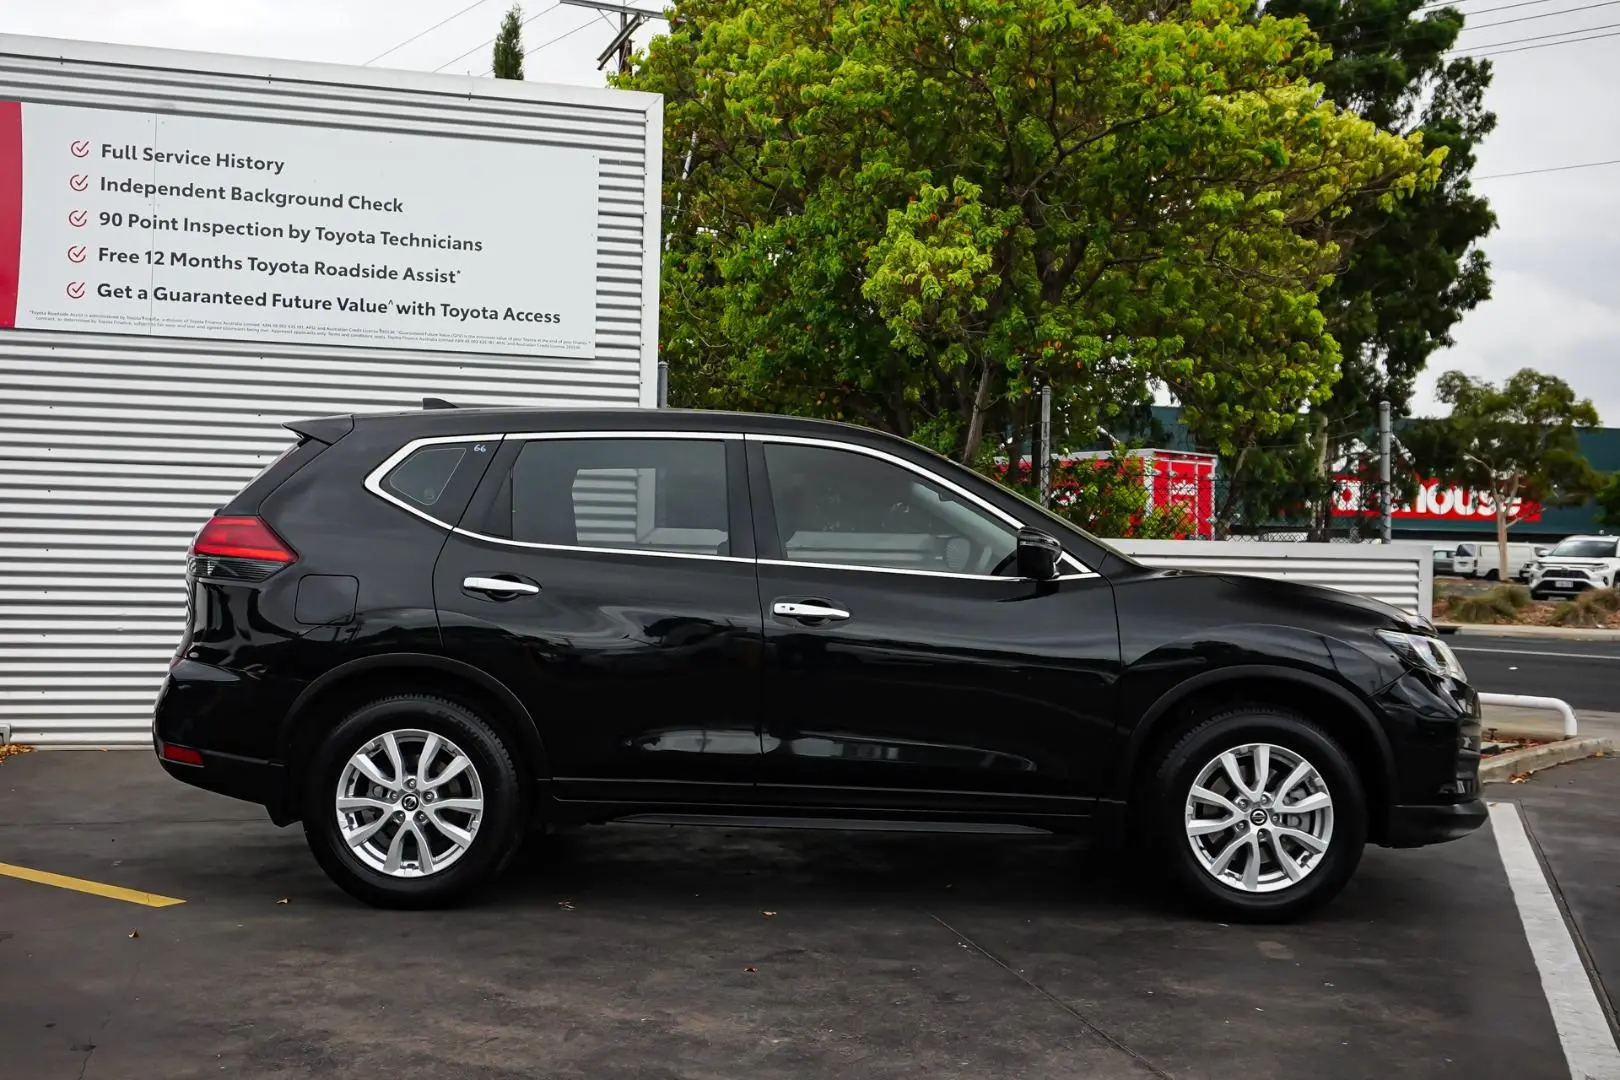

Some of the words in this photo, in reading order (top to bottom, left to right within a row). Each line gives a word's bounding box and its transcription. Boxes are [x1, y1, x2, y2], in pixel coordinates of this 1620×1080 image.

[101, 143, 138, 160] Full
[144, 147, 211, 167] Service
[216, 153, 285, 175] History
[100, 176, 226, 200] Independent
[231, 186, 344, 209] Background
[347, 195, 403, 213] Check
[99, 211, 123, 227] 90
[128, 213, 179, 231] Point
[183, 217, 284, 239] Inspection
[288, 223, 311, 243] by
[315, 226, 376, 247] Toyota
[380, 231, 483, 252] Technicians
[98, 247, 140, 264] Free
[144, 250, 166, 266] 12
[170, 251, 243, 271] Months
[247, 256, 309, 276] Toyota
[314, 261, 399, 281] Roadside
[97, 283, 133, 300] Get
[137, 289, 148, 300] a
[153, 286, 267, 308] Guaranteed
[272, 293, 333, 311] Future
[395, 300, 436, 317] with
[440, 303, 499, 323] Toyota
[502, 307, 561, 325] Access
